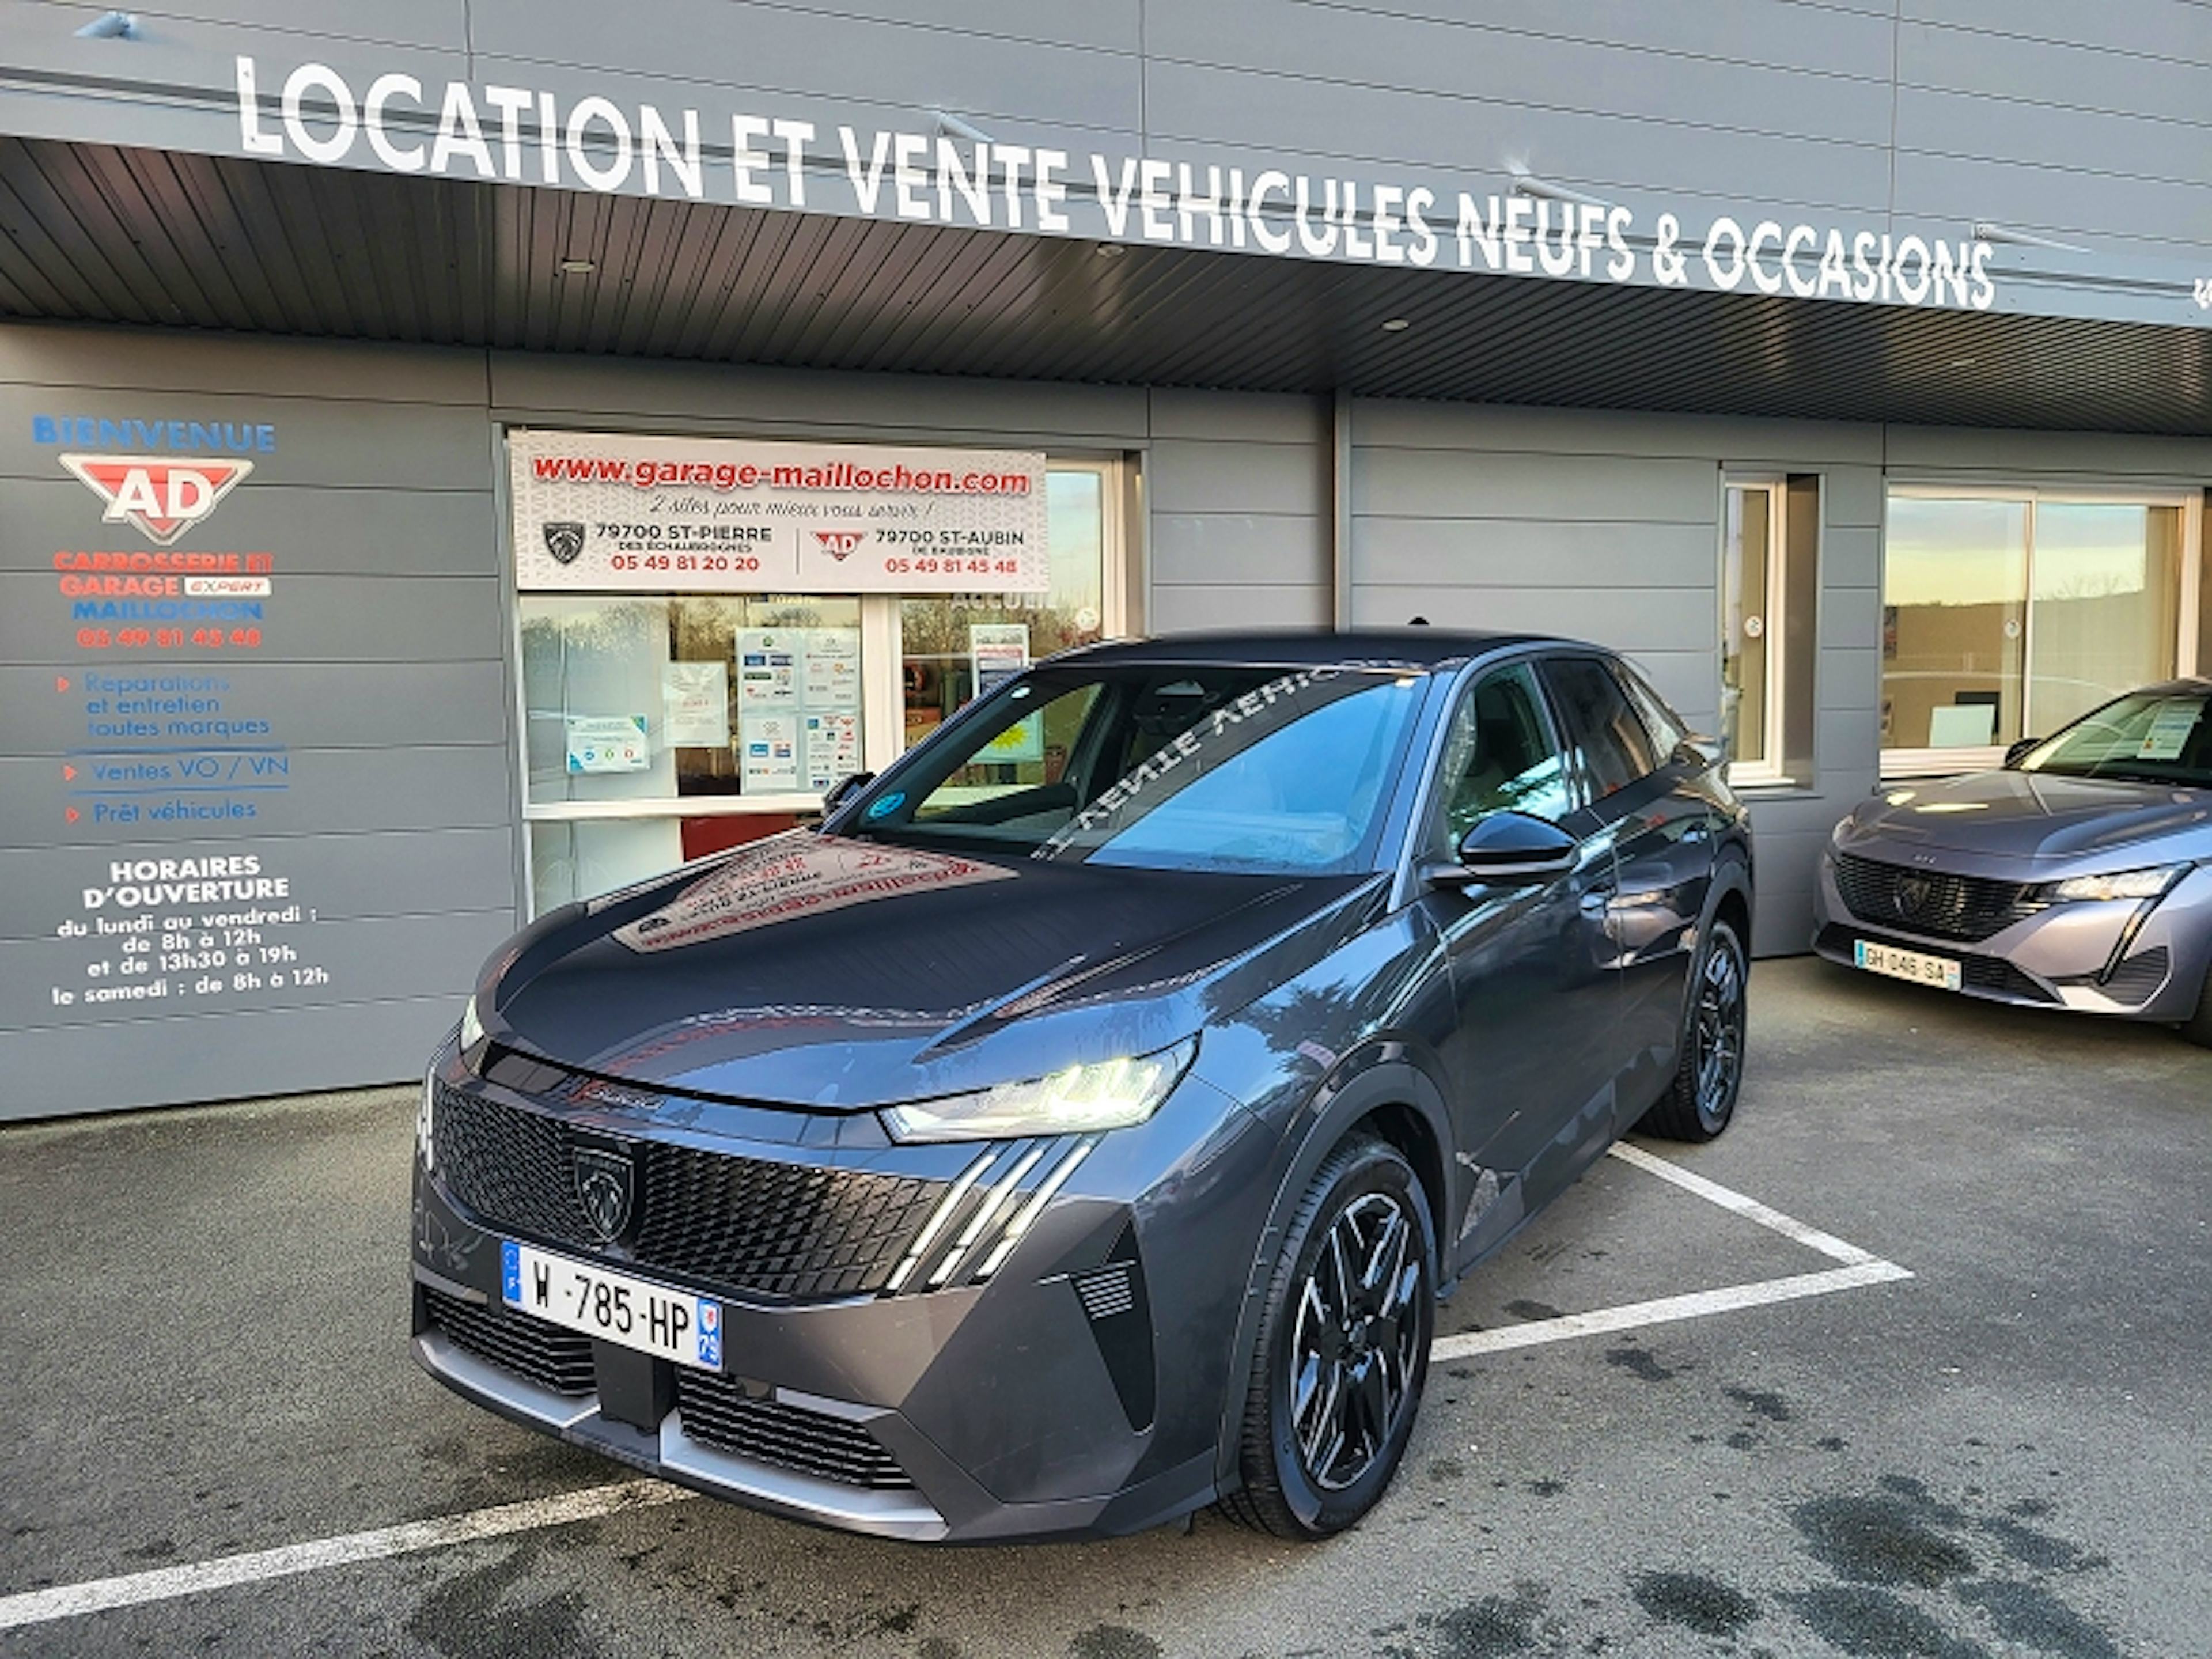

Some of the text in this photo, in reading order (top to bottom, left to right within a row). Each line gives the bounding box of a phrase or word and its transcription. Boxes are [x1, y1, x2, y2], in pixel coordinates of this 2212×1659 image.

[236, 56, 1995, 310] LOCATION ET VENTE VEHICULES NEUFS & OCCASIONS
[32, 414, 275, 453] BIENVENUE
[534, 457, 1030, 493] www.garage-maillochon.com
[107, 469, 217, 520] AD
[596, 524, 772, 542] 79700 ST-PIERRE
[826, 535, 857, 554] AD
[876, 529, 1024, 545] 79700 ST-AUBIN
[53, 551, 274, 574] CARROSSERIE ET
[611, 555, 760, 571] 05 49 81 20 20
[885, 558, 910, 573] 05
[915, 559, 938, 573] 49
[60, 576, 264, 597] GARAGE EXPERT
[72, 601, 263, 620] MAILLOCHON
[76, 629, 110, 647] 05
[116, 630, 150, 647] 49
[86, 697, 219, 715] et entretien
[88, 719, 270, 740] toutes marques
[92, 763, 172, 781] Ventes
[178, 756, 219, 778] VO
[248, 756, 288, 775] VN
[94, 800, 256, 823] Prêt véhicules
[109, 855, 262, 883] HORAIRES
[82, 878, 289, 909] D'OUVERTURE
[57, 921, 87, 937] du
[96, 915, 155, 934] lundi
[163, 916, 192, 930] au
[200, 906, 301, 927] vendredi
[122, 929, 262, 953] de 8h à 12h
[87, 945, 297, 978] et de 13h30 à 19h
[51, 987, 74, 1005] le
[84, 980, 168, 1002] samedi
[195, 975, 224, 993] de
[233, 972, 262, 990] 8h
[291, 966, 330, 986] 12h
